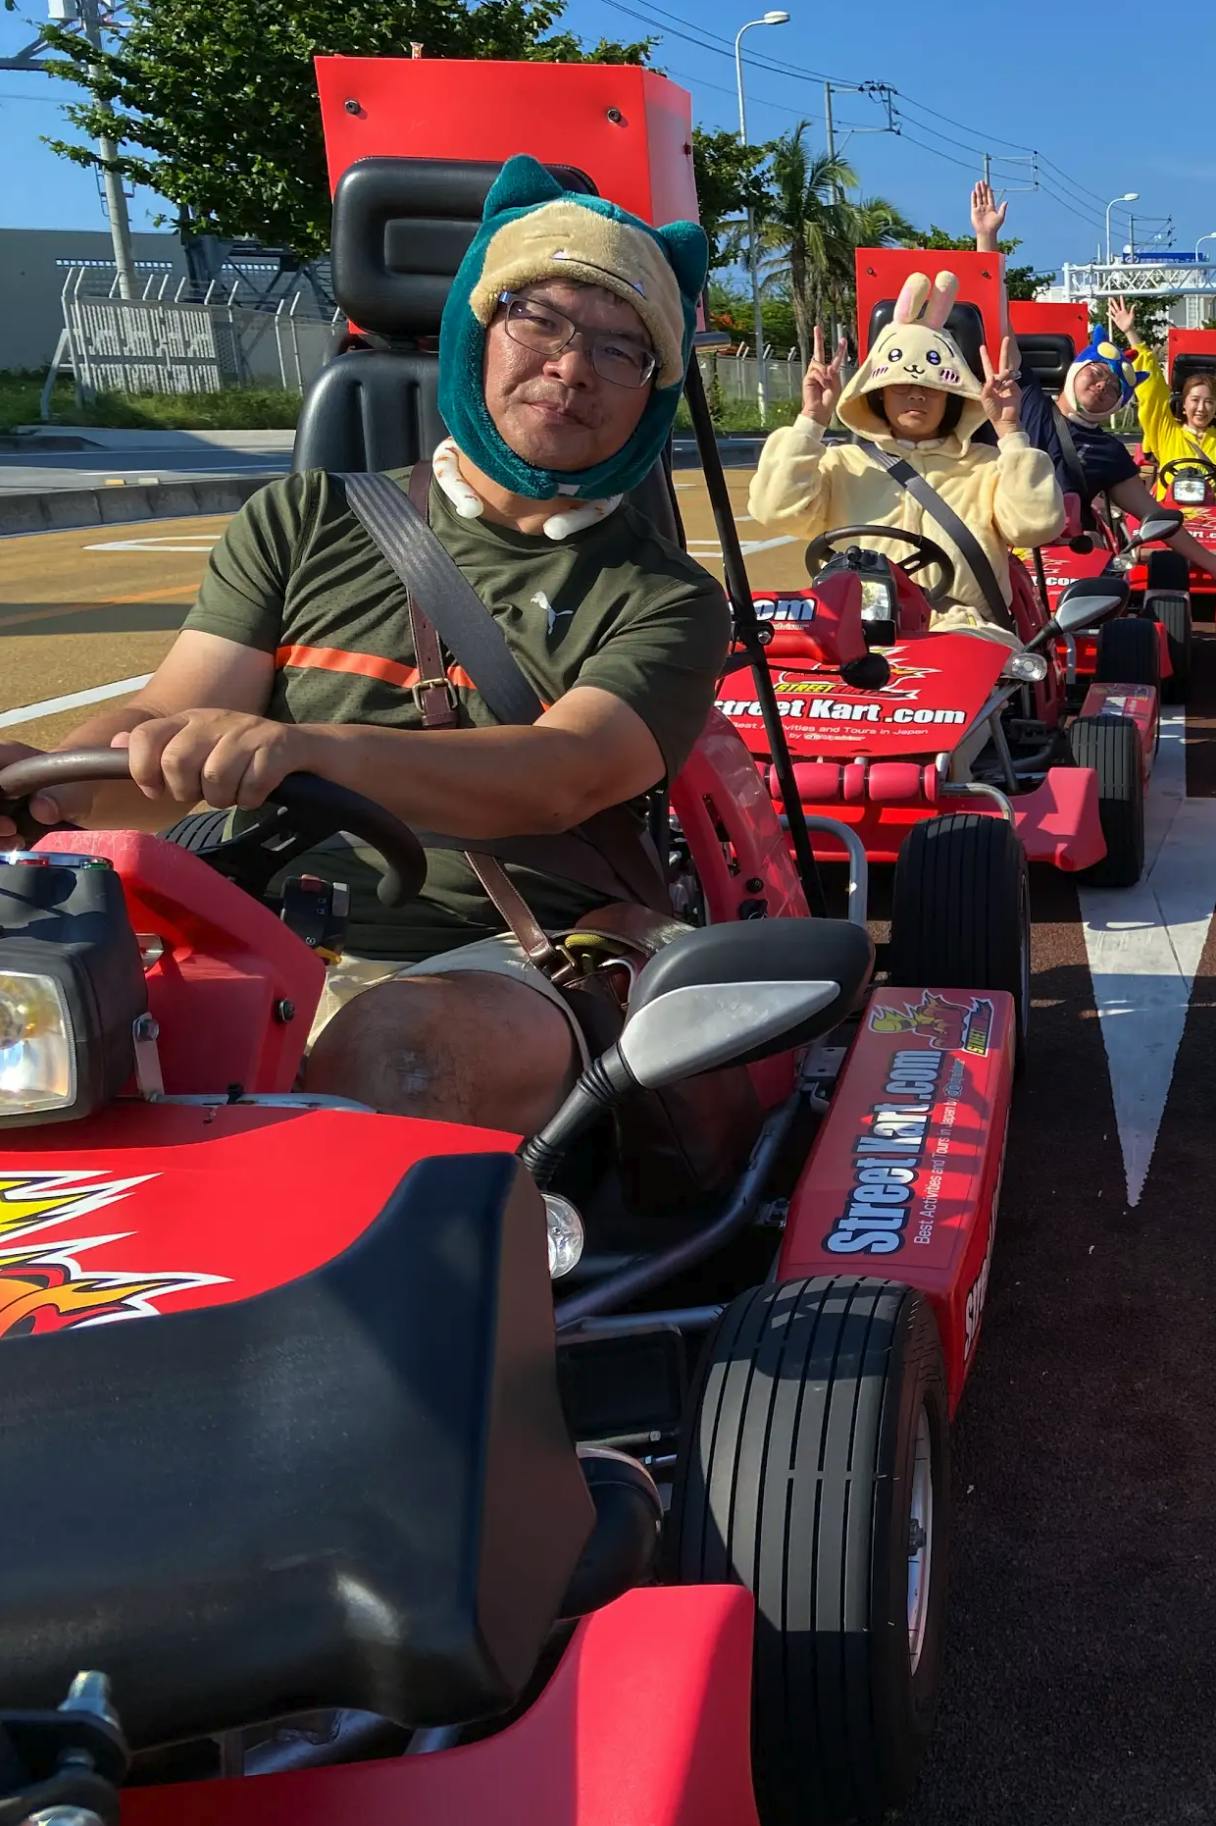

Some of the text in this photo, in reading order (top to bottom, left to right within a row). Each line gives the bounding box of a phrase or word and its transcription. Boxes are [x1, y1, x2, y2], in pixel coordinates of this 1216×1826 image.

[753, 599, 815, 621] om
[844, 726, 877, 735] Tours
[893, 728, 929, 736] Japan
[941, 1106, 957, 1127] Japan
[933, 1137, 950, 1157] Tours
[931, 1160, 945, 1174] and
[828, 1157, 918, 1254] Street
[920, 1176, 942, 1217] Activities
[914, 1220, 934, 1244] Best
